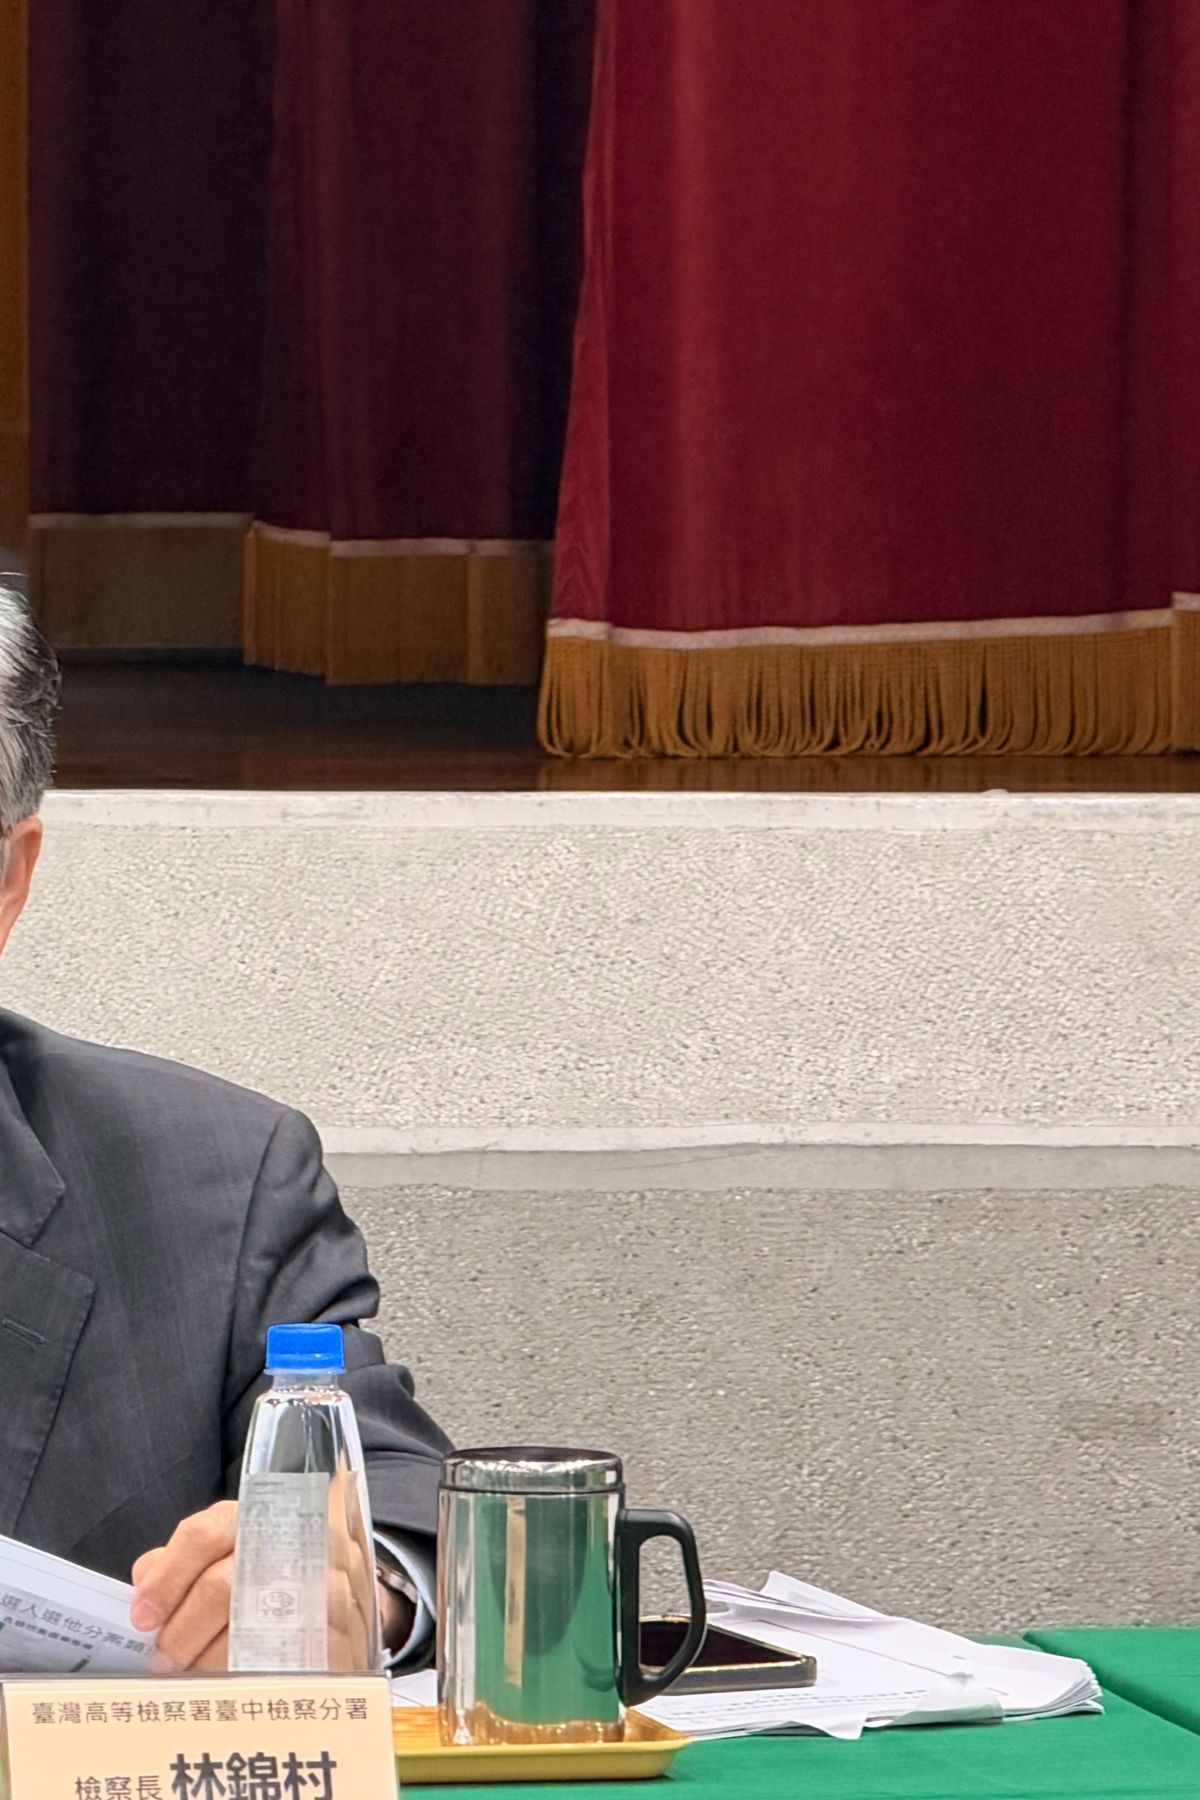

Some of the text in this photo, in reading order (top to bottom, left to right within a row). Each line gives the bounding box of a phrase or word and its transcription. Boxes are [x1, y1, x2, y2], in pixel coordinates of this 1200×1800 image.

[32, 1697, 368, 1724] 臺灣高等檢察署臺中檢察分署
[74, 1751, 338, 1800] 檢察長 林錦村
